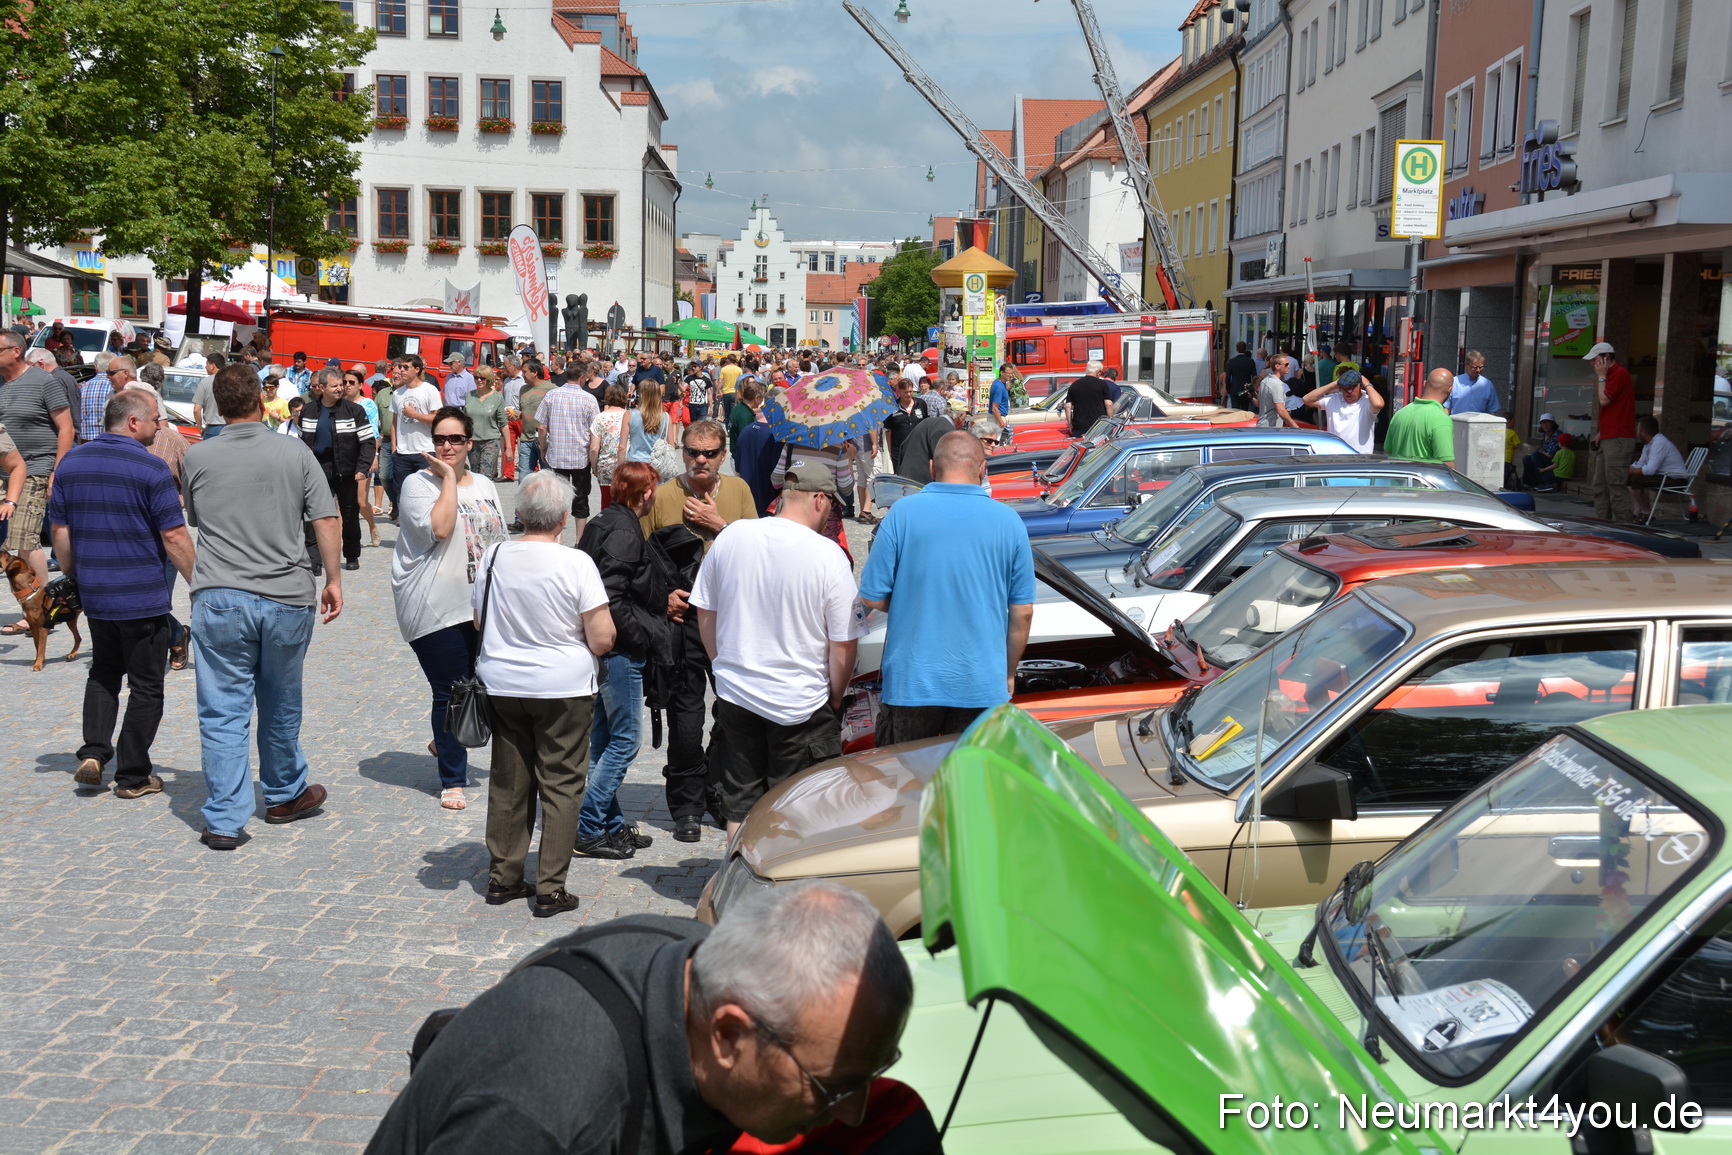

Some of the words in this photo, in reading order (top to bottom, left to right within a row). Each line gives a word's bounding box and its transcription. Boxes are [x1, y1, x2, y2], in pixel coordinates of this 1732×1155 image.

[1520, 120, 1562, 194] fries
[1402, 188, 1433, 196] Marktplatz
[76, 250, 104, 269] WC
